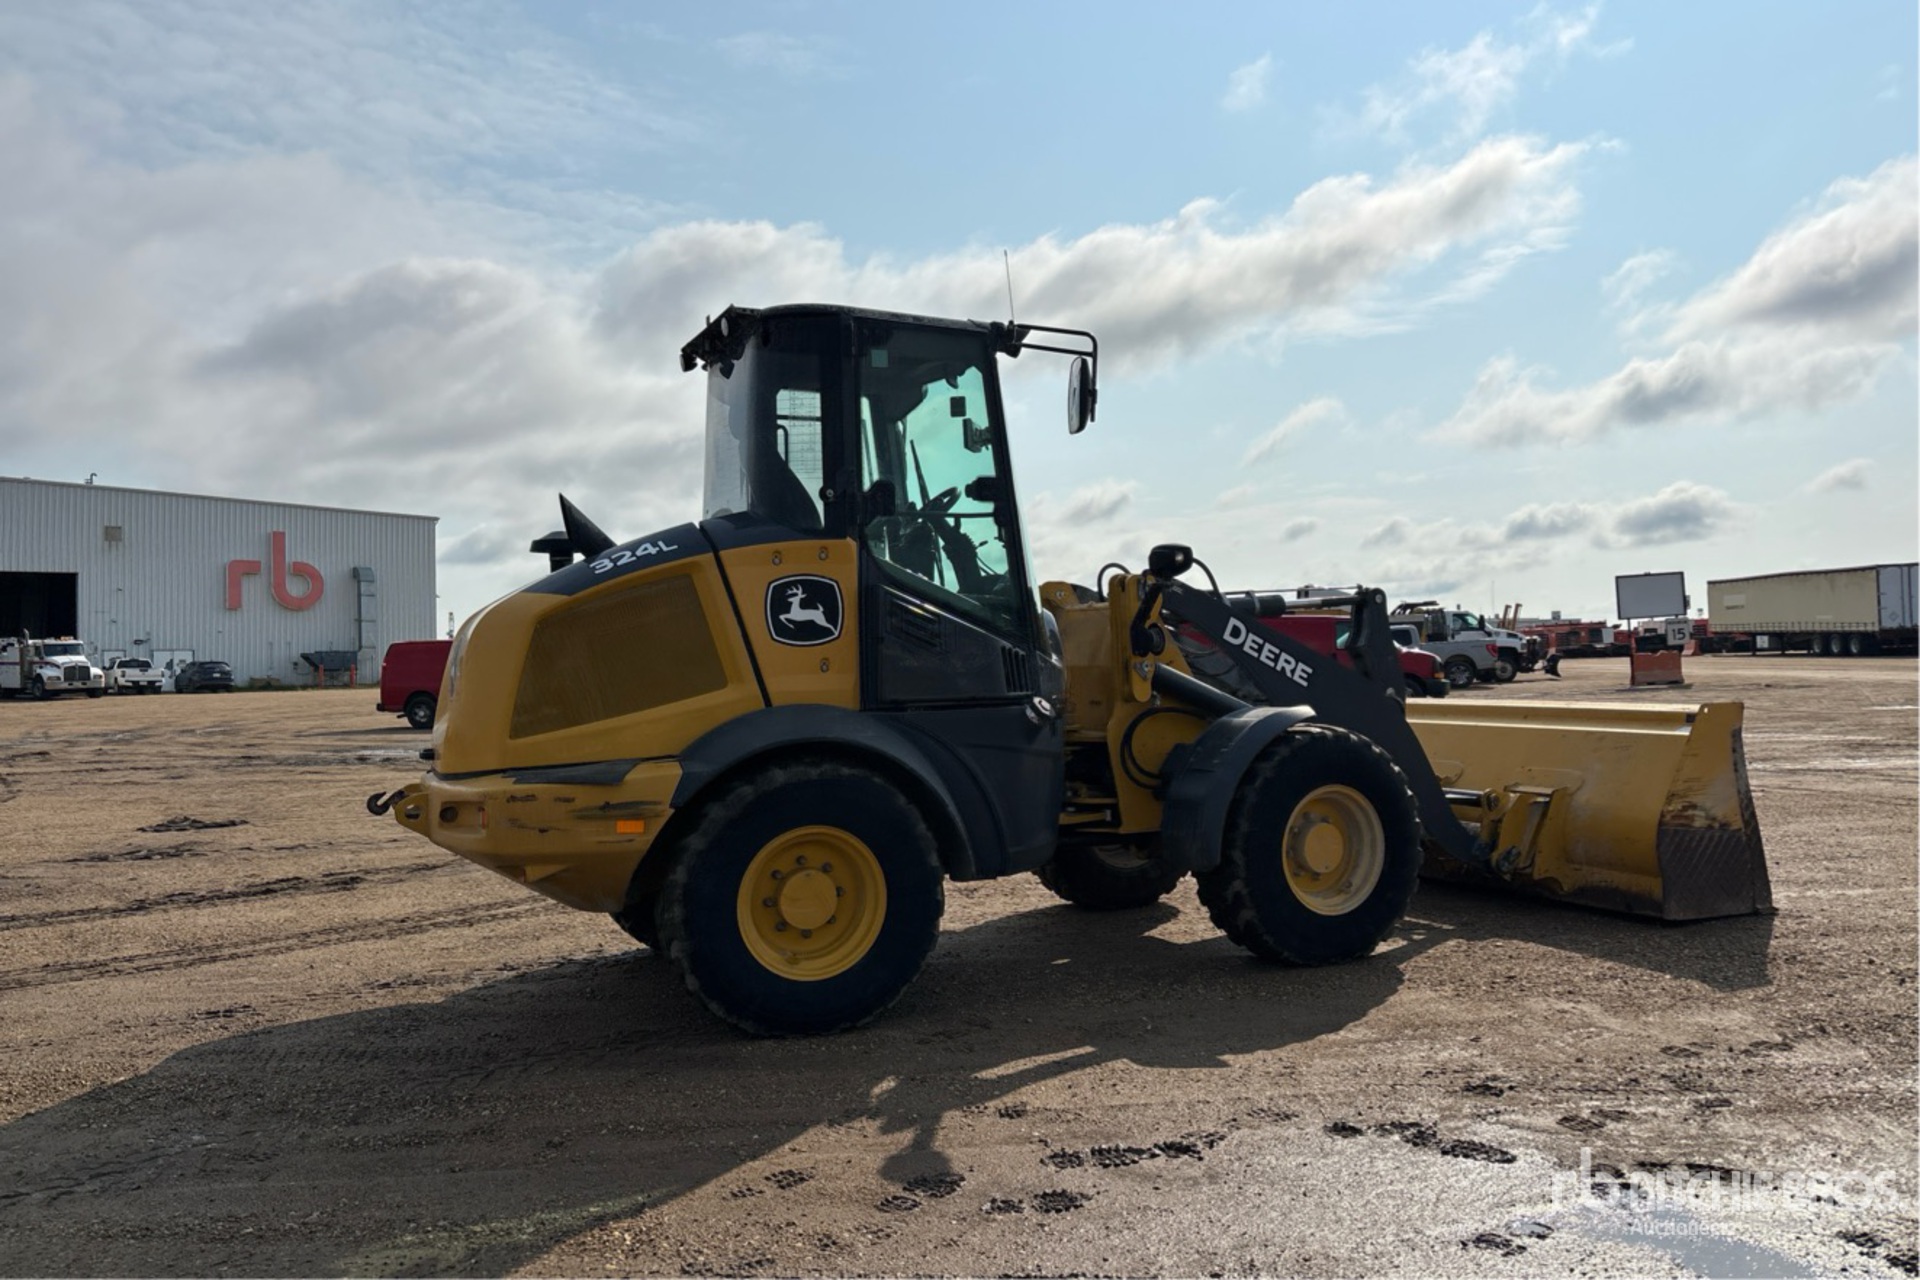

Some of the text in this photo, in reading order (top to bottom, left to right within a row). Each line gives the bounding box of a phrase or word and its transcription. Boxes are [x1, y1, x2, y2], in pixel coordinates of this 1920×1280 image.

[226, 530, 325, 611] rb
[589, 540, 679, 574] 324L
[1222, 616, 1314, 688] DEERE
[1671, 627, 1686, 641] 15
